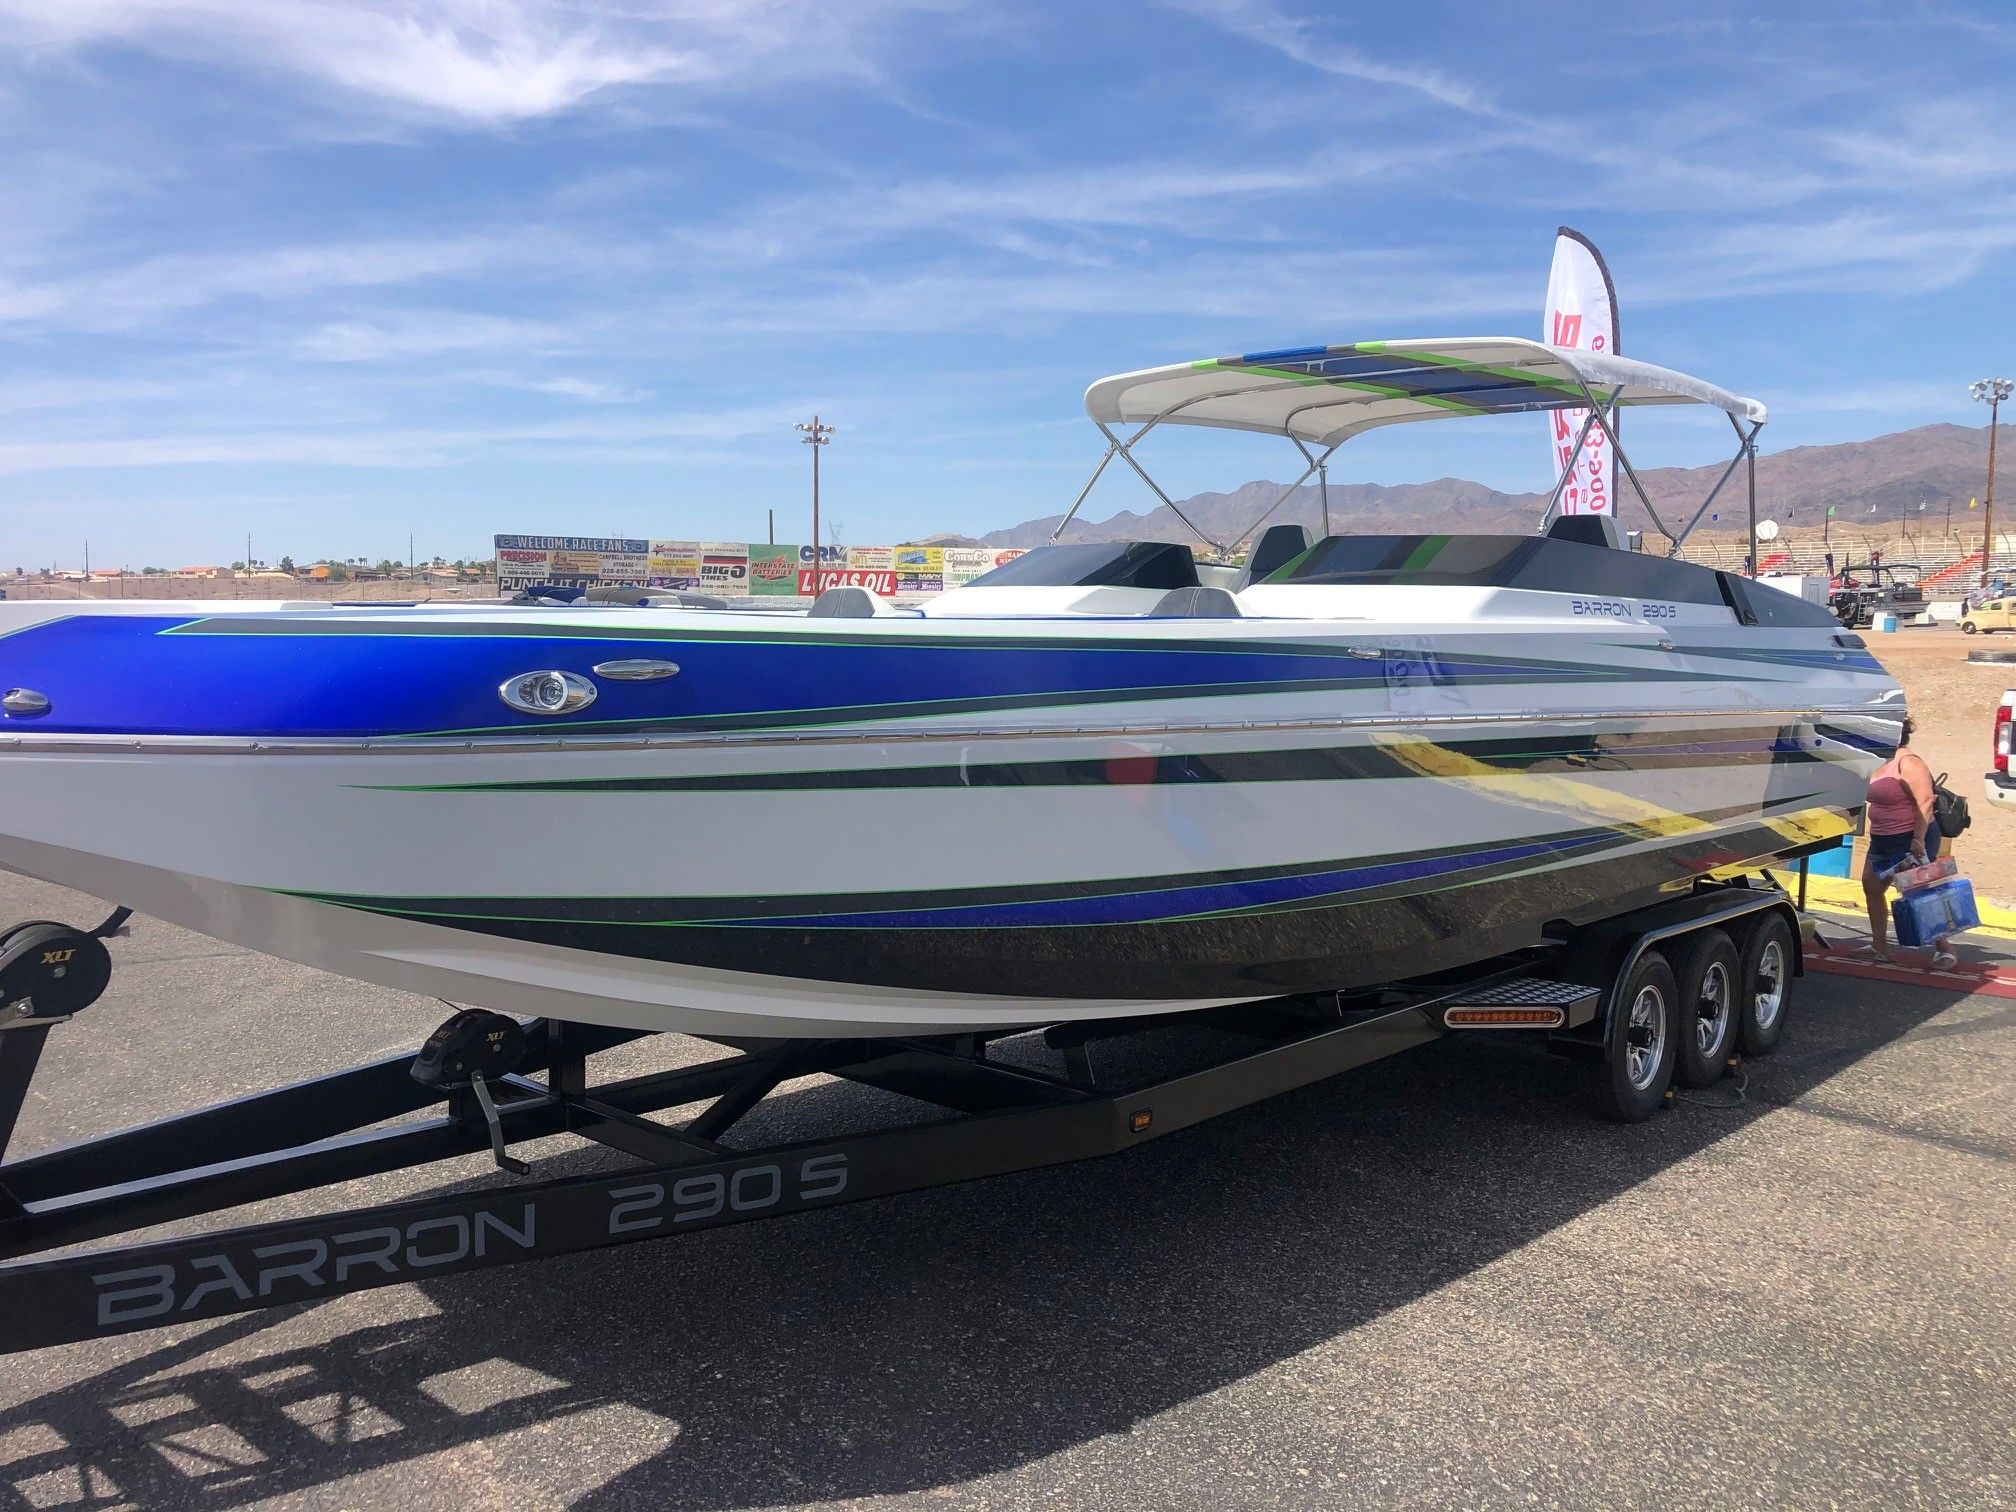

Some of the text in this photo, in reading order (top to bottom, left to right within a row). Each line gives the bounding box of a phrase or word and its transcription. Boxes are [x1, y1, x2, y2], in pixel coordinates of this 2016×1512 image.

[517, 536, 629, 552] WELCOME RACE FANS
[701, 565, 730, 575] BIG
[501, 577, 554, 590] PUNCH
[801, 572, 892, 593] LUCAS OIL
[1571, 600, 1632, 617] BARRON
[41, 948, 76, 964] XLT
[91, 1153, 848, 1325] BARRON 290 S
